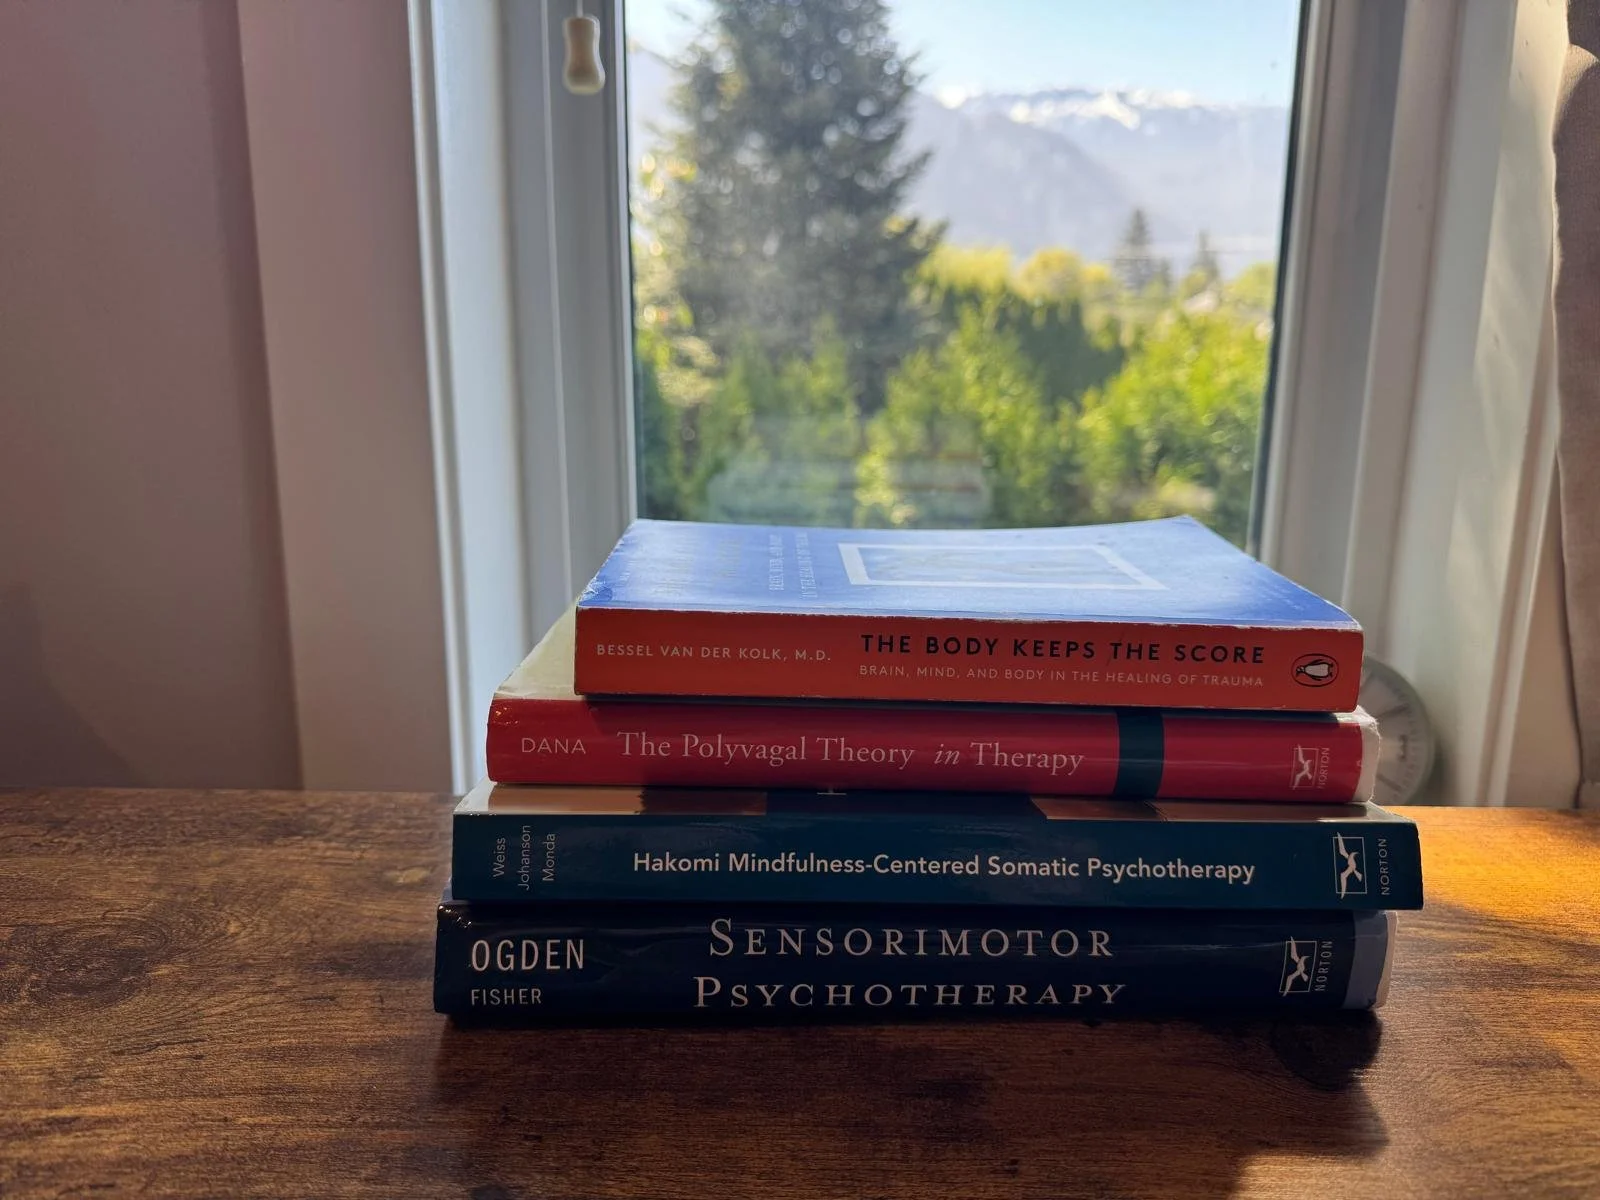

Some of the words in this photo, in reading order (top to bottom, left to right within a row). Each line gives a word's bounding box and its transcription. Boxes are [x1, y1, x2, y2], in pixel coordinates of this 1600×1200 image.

[596, 643, 654, 657] BESSEL
[660, 645, 693, 657] VAN
[700, 646, 732, 659] DER
[738, 647, 788, 662] KOLK,
[795, 649, 831, 661] M.D.
[860, 634, 911, 654] THE
[926, 636, 999, 656] BODY
[1012, 638, 1095, 659] KEEPS
[1109, 641, 1161, 661] THE
[1173, 644, 1265, 664] SCORE
[859, 664, 910, 678] BRAIN,
[916, 666, 960, 679] MIND,
[966, 668, 998, 679] AND
[1004, 668, 1045, 681] BODY
[1050, 670, 1065, 681] IN
[1071, 670, 1099, 683] THE
[1105, 671, 1172, 685] HEALING
[1177, 673, 1198, 685] OF
[1202, 674, 1264, 687] TRAUMA
[520, 737, 587, 755] DANA
[616, 731, 671, 757] The
[681, 733, 807, 767] Polyvagal
[815, 736, 916, 770] Theory
[934, 743, 960, 765] in
[969, 741, 1085, 776] Therapy
[492, 836, 507, 878] Weiss
[517, 824, 532, 891] Johanson
[541, 832, 556, 882] Monda
[633, 851, 720, 873] Hakomi
[728, 851, 980, 875] Mindfulness-Centered
[988, 855, 1080, 877] Somatic
[1087, 857, 1256, 885] Psychotherapy
[1377, 837, 1390, 896] NORTON
[709, 917, 1114, 957] SENSORIMOTOR
[471, 939, 584, 972] OGDEN
[1314, 939, 1333, 992] NORTON
[470, 987, 542, 1006] FISHER
[692, 975, 1126, 1008] PSYCHOTHERAPY
